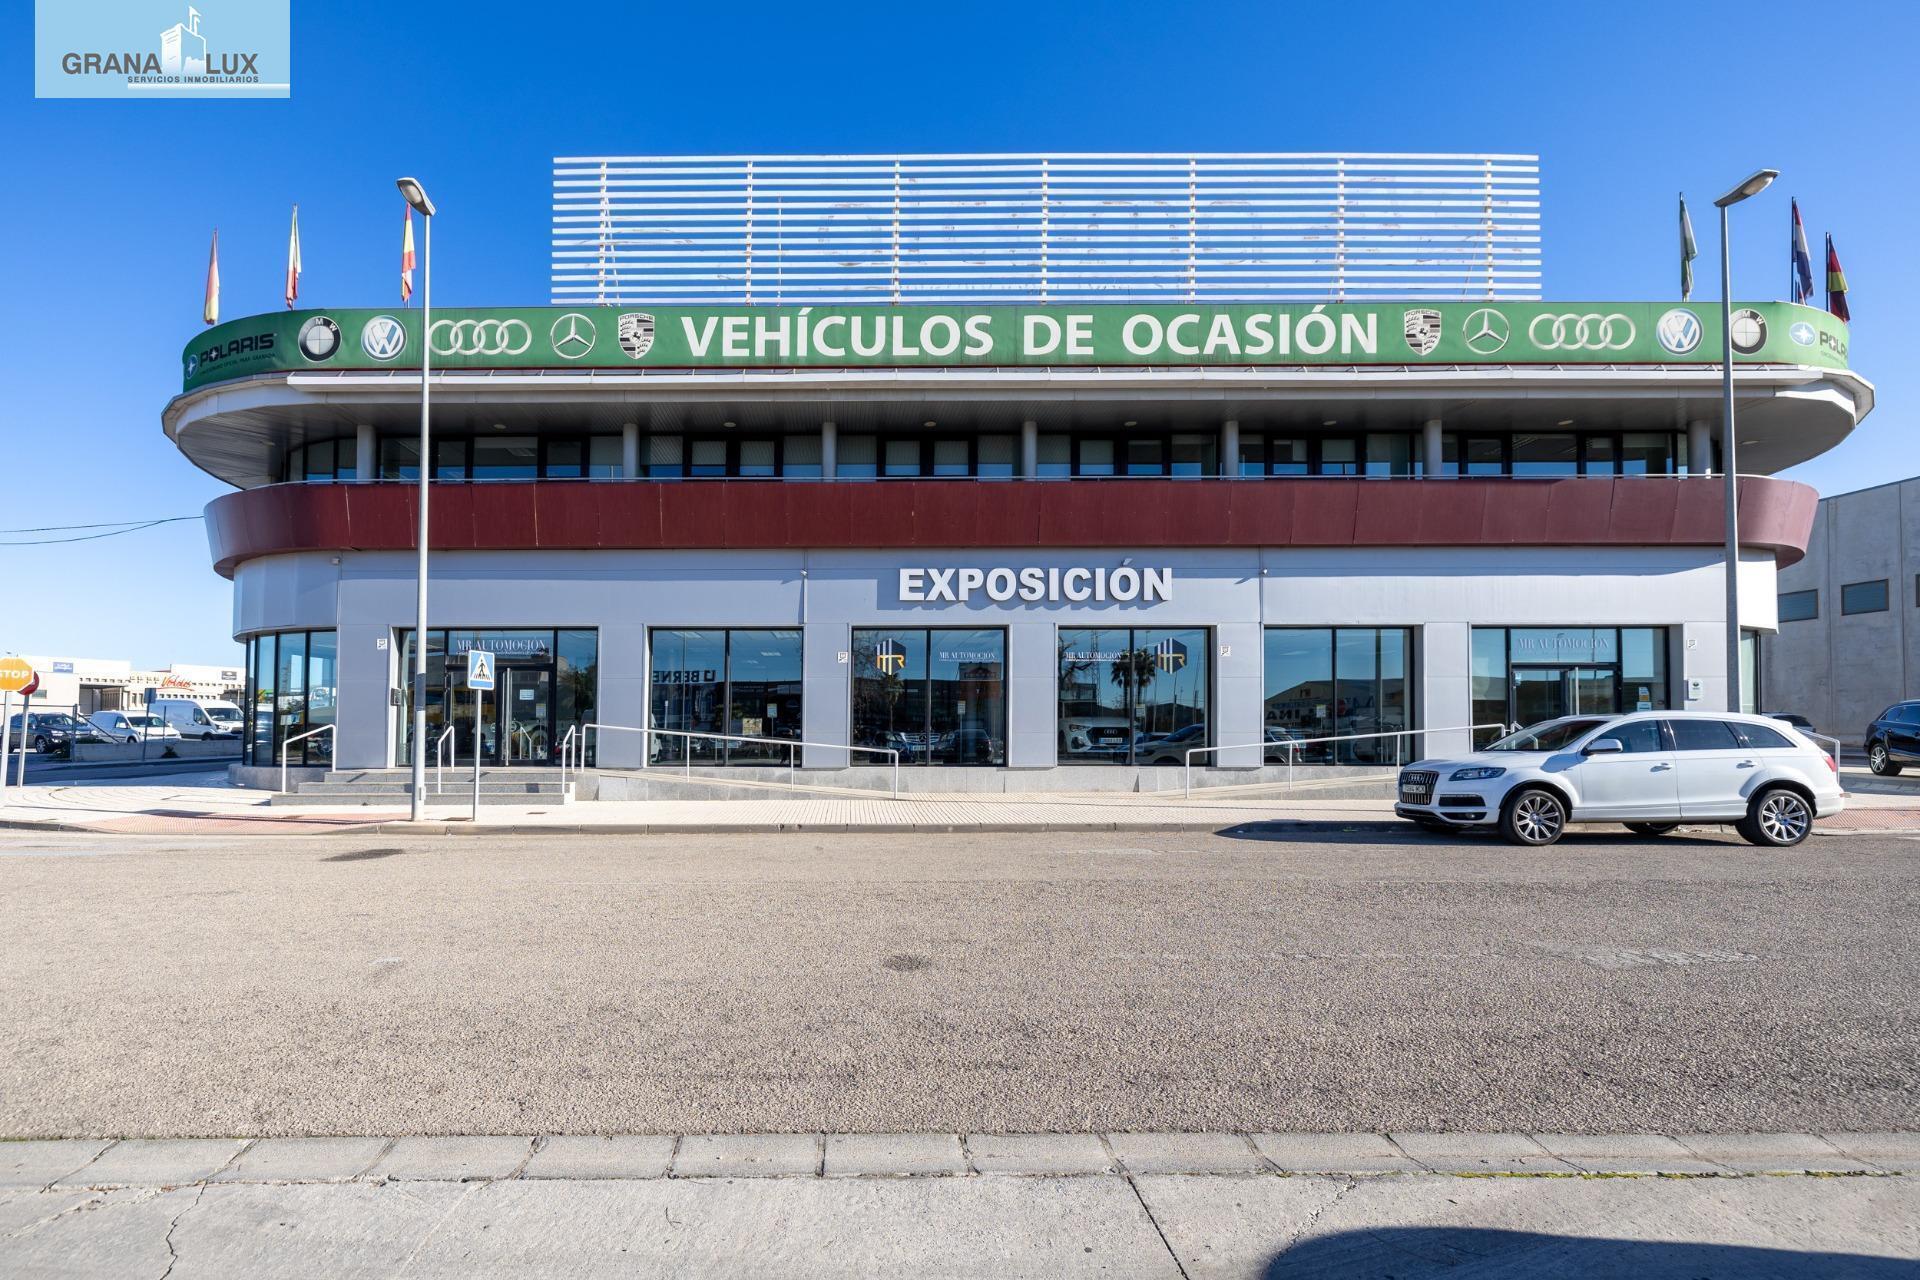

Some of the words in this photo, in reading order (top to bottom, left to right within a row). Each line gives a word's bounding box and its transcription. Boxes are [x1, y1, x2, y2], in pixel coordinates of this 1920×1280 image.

[619, 313, 654, 321] PORSCHE
[1405, 309, 1441, 317] PORSCHE
[681, 306, 993, 358] VEHÍCULOS
[1024, 314, 1094, 356] DE
[1122, 304, 1378, 358] OCASIÓN
[200, 333, 274, 366] POLARIS
[899, 558, 1173, 601] EXPOSICIÓN
[457, 639, 472, 651] MR
[476, 637, 546, 651] AUTOMOCIÓN
[0, 670, 30, 679] TOP
